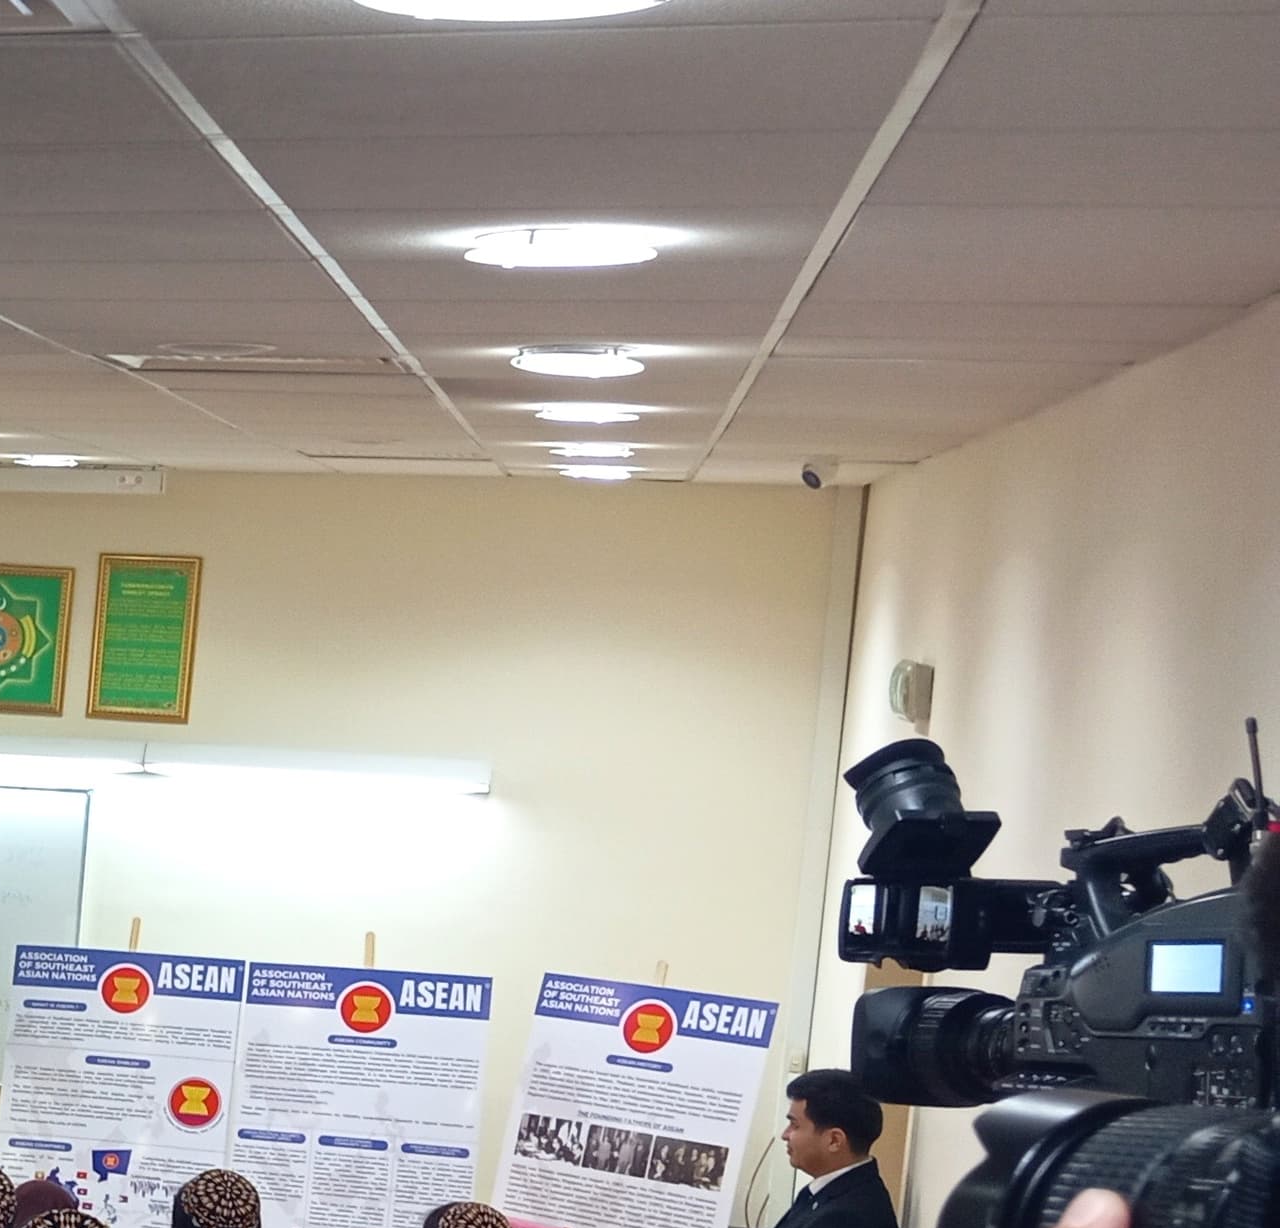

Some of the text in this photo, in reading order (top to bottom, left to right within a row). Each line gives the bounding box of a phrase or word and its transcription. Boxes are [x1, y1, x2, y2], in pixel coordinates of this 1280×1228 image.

[20, 951, 88, 963] ASSOCIATION
[18, 960, 95, 973] OF SOUTHEAST
[18, 969, 97, 982] ASIAN NATIONS
[157, 961, 236, 994] ASEAN
[253, 969, 325, 981] ASSOCIATION
[252, 978, 333, 991] OF SOUTHEAST
[545, 980, 615, 997] ASSOCIATION
[251, 988, 335, 1001] ASIAN NATIONS
[399, 979, 482, 1013] ASEAN
[543, 989, 621, 1008] OF SOUTHEAST
[541, 999, 620, 1018] ASIAN NATIONS
[682, 1000, 768, 1040] ASEAN
